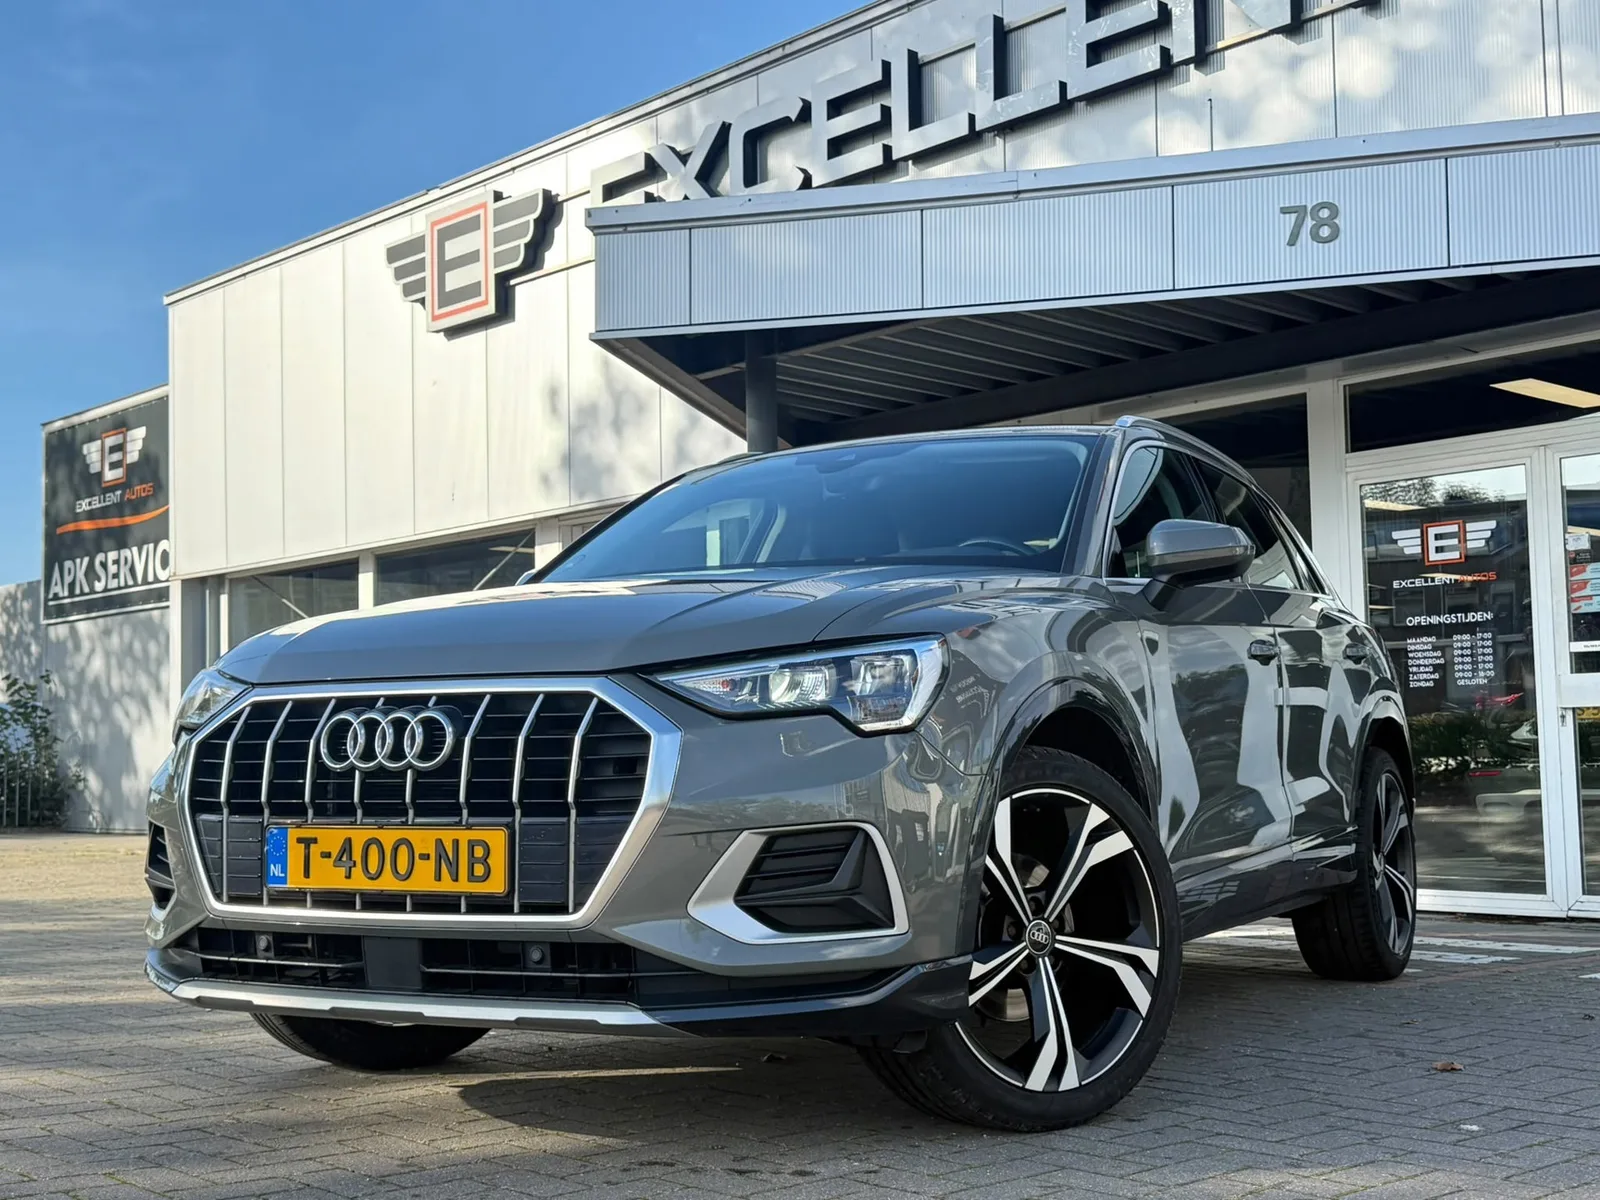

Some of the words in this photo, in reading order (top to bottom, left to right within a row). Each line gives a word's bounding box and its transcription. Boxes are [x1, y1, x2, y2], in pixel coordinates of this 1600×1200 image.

[1279, 201, 1340, 246] 78
[437, 213, 482, 310] E
[104, 433, 124, 482] E
[75, 490, 122, 513] EXCELLENT
[124, 482, 154, 501] AUTOS
[1427, 524, 1461, 561] E
[48, 555, 90, 599] APK
[1393, 577, 1456, 588] EXCELLENT
[1458, 571, 1497, 582] AUTOS
[1406, 611, 1494, 627] OPENINGSTIJDEN:
[1409, 680, 1434, 688] ZONDAG
[1457, 678, 1488, 686] GESLOTEN
[270, 863, 285, 877] NL
[296, 837, 491, 883] T-400-NB
